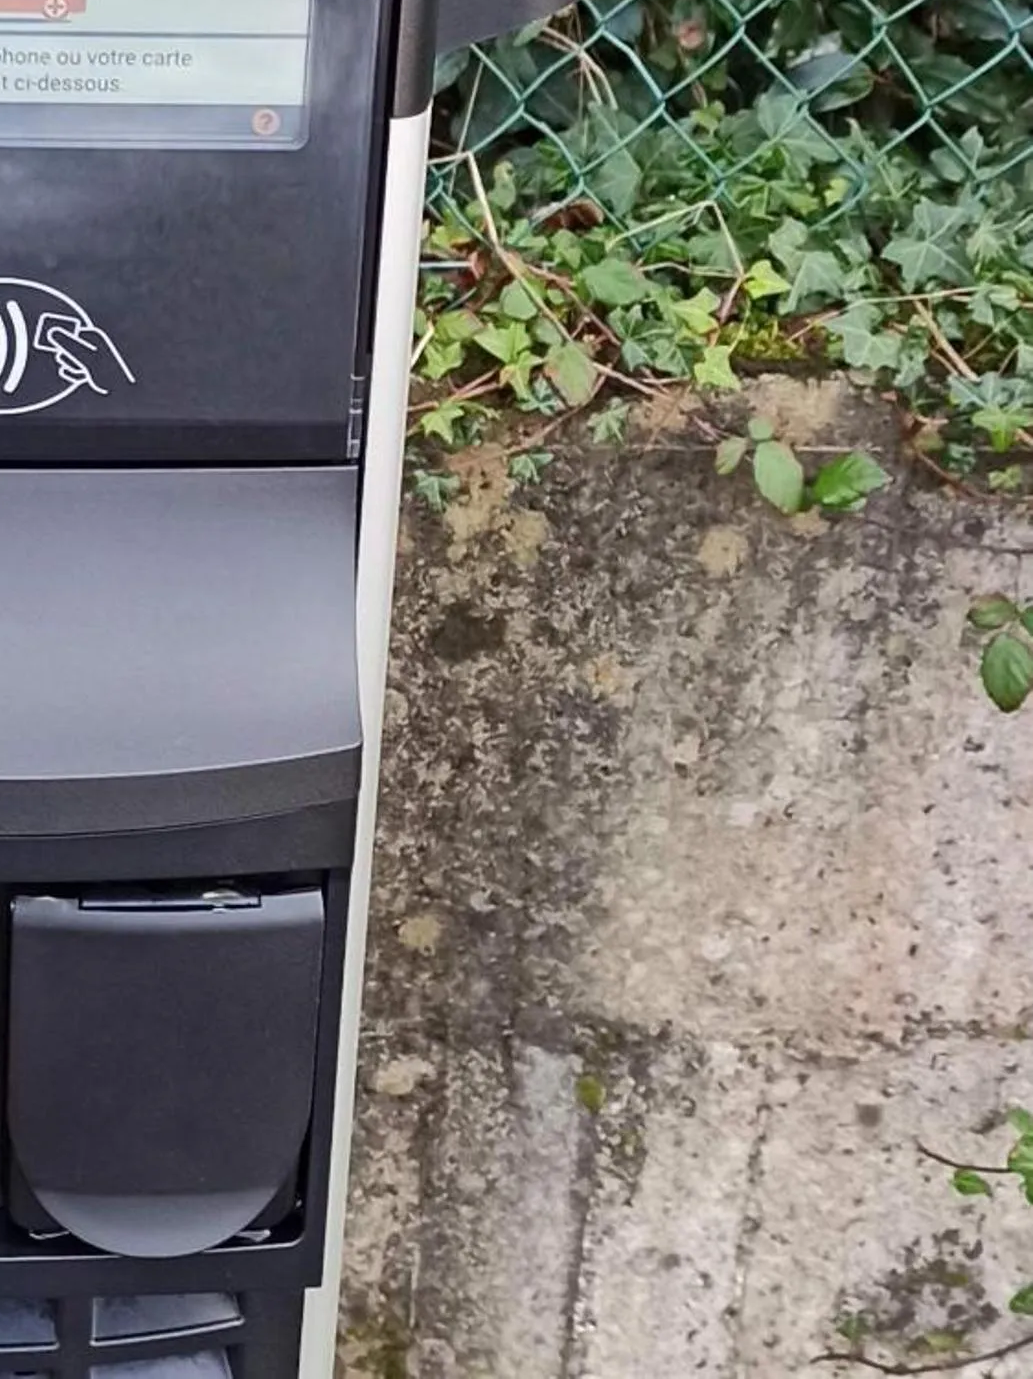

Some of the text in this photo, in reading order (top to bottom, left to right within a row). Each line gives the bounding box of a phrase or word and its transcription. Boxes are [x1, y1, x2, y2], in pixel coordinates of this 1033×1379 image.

[56, 54, 82, 66] ou
[87, 51, 137, 67] votre
[141, 52, 193, 67] carte
